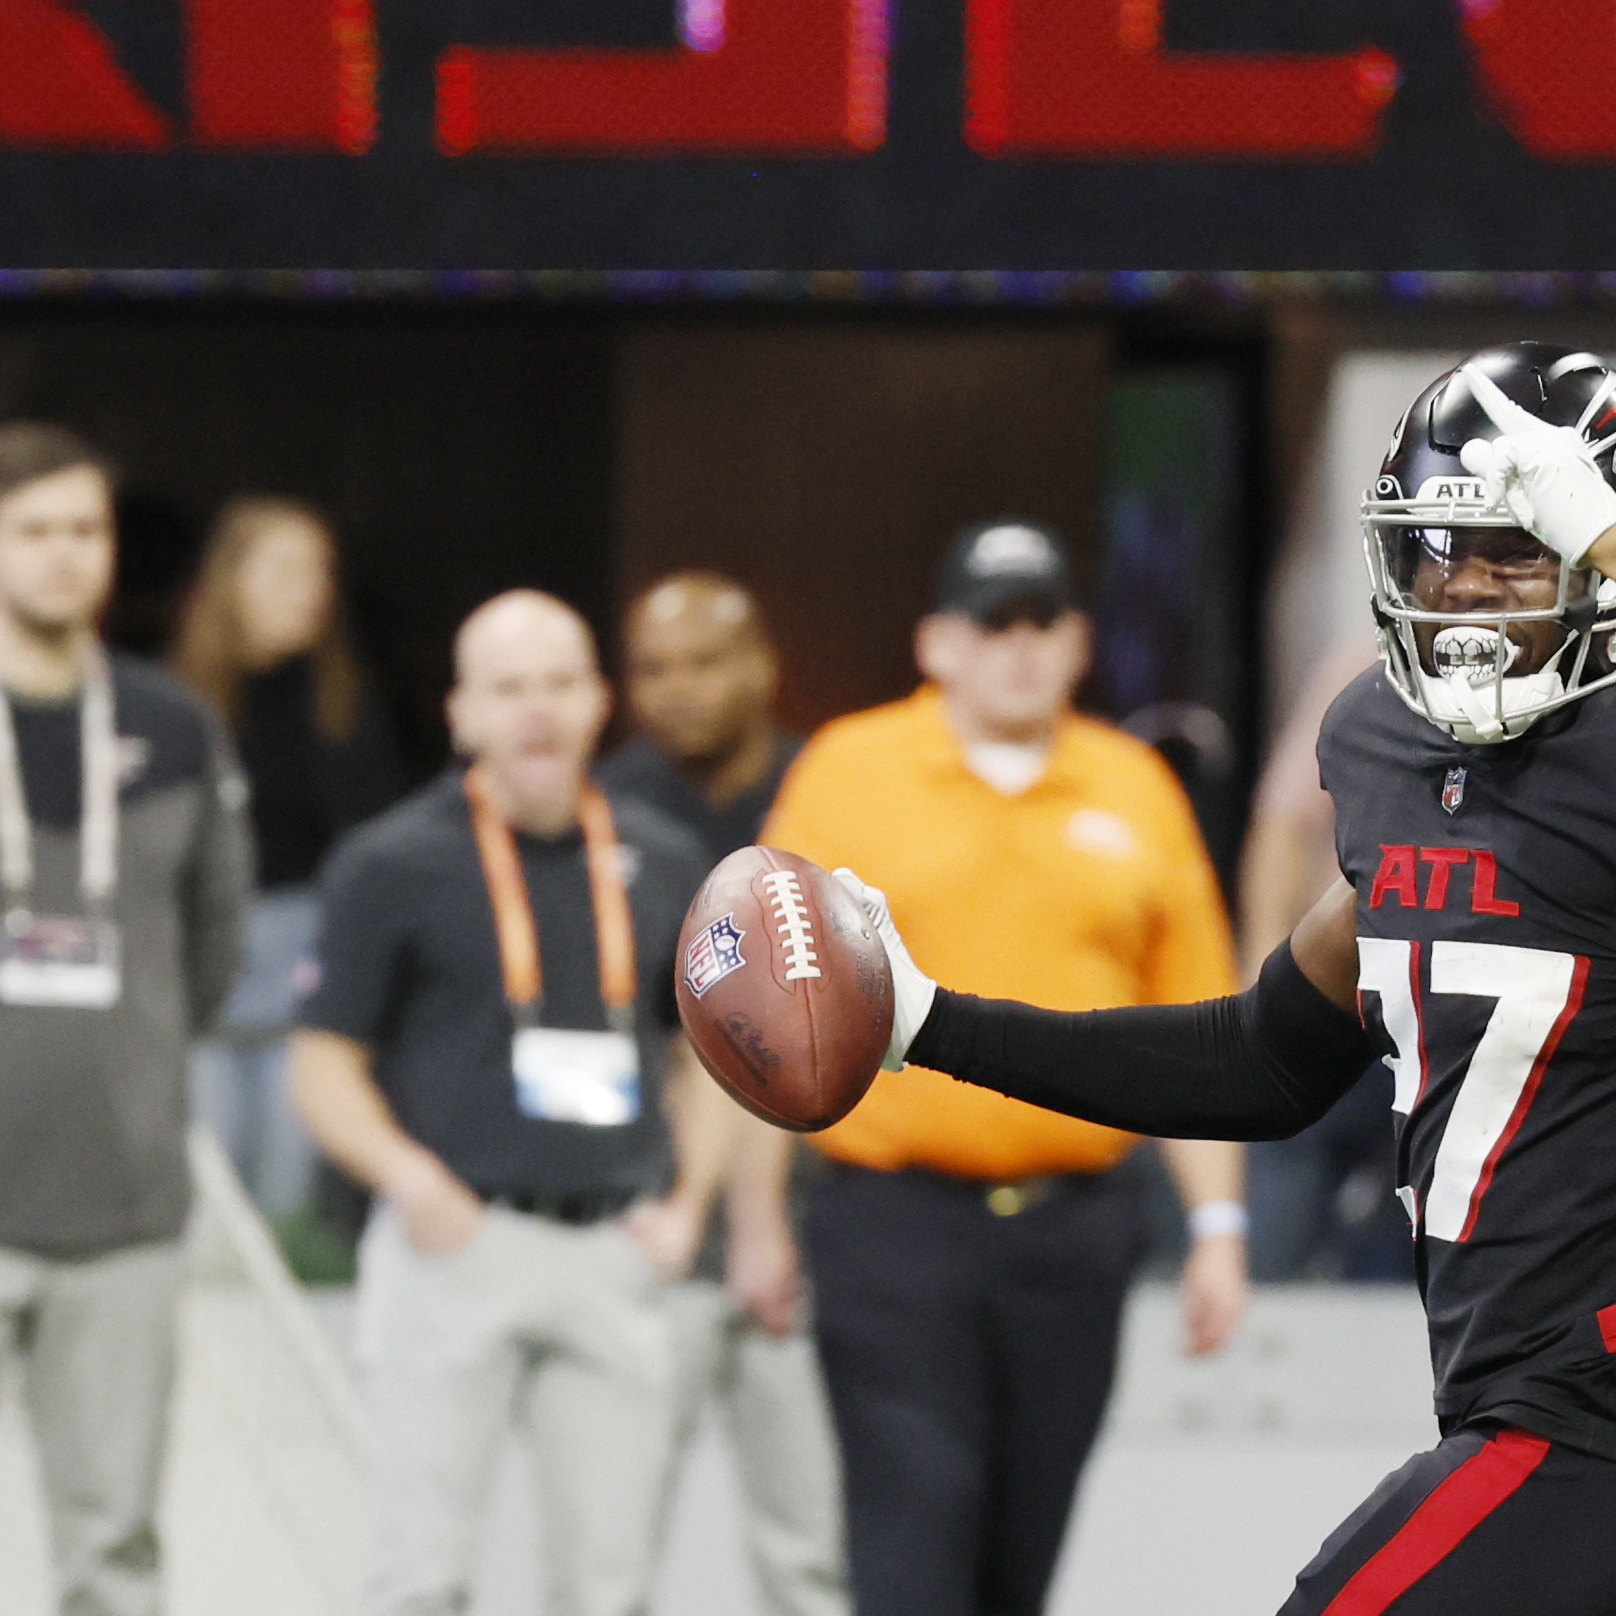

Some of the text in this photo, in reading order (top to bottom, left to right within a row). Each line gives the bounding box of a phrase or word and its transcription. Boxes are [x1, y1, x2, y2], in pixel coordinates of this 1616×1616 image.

[1437, 483, 1484, 498] ATL
[1368, 844, 1521, 917] ATL
[687, 931, 716, 988] NFL
